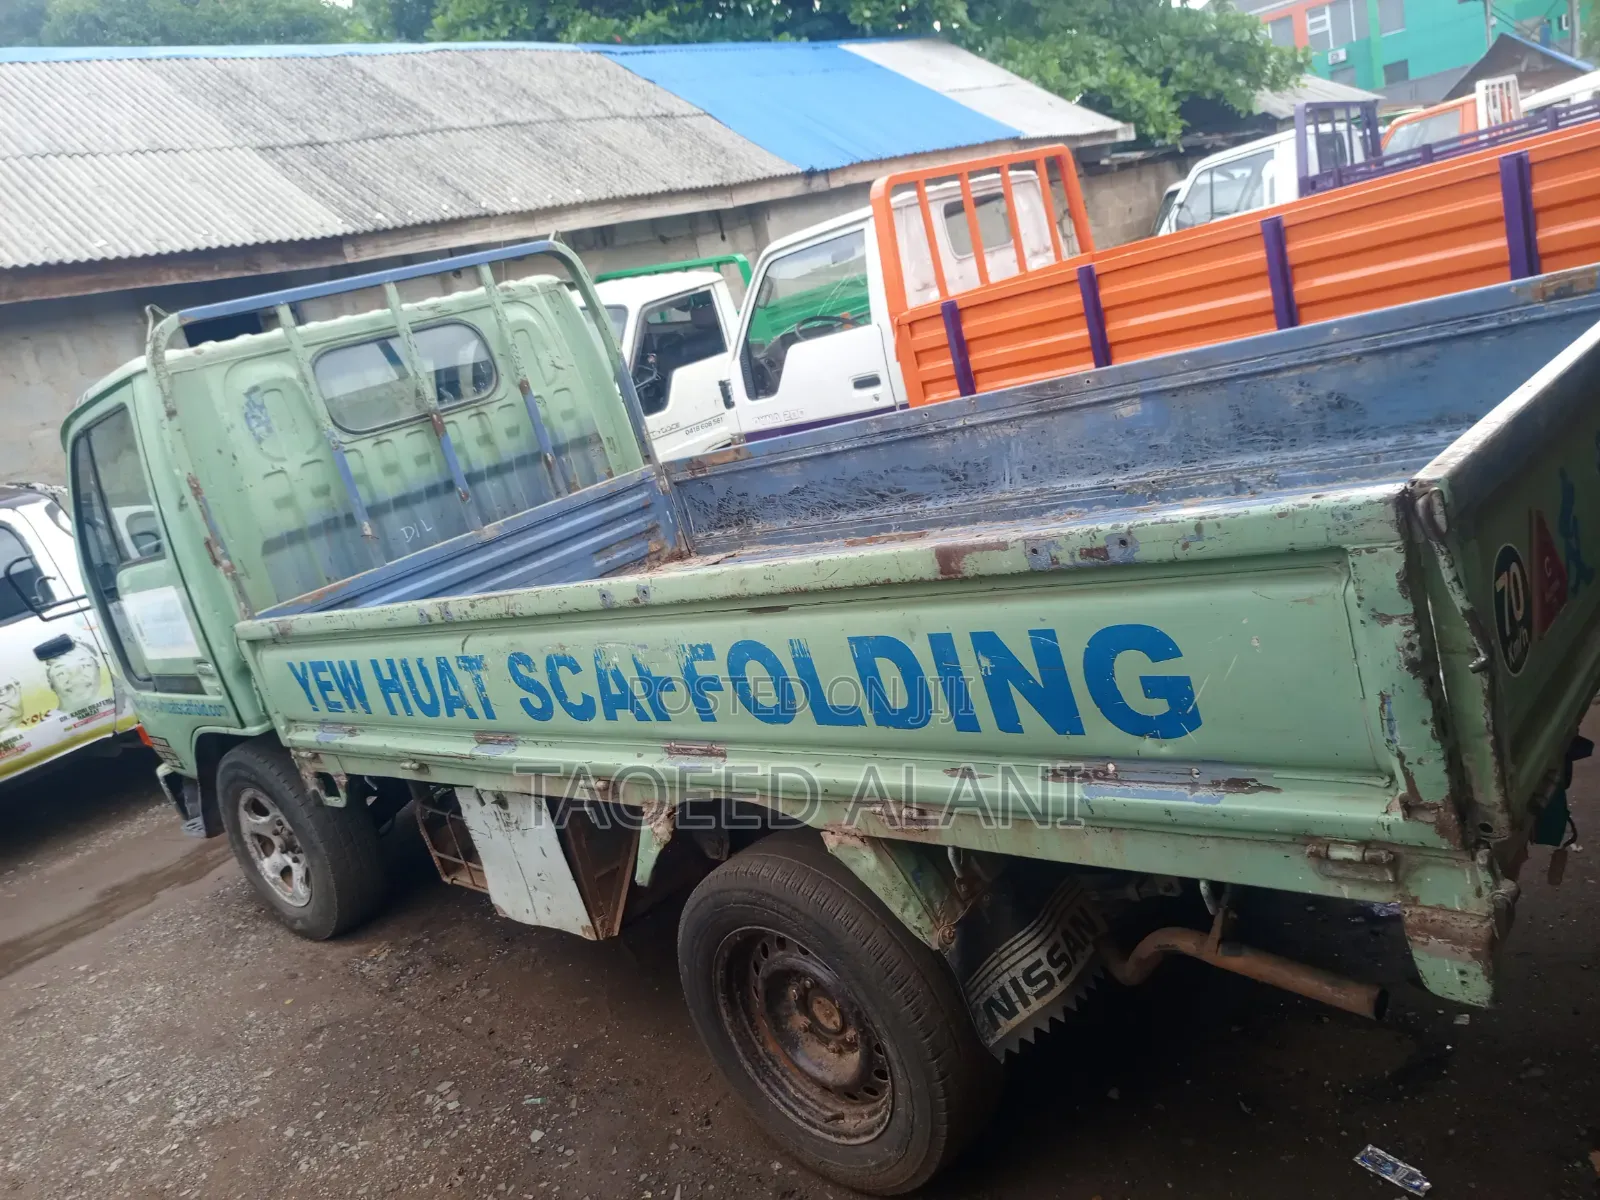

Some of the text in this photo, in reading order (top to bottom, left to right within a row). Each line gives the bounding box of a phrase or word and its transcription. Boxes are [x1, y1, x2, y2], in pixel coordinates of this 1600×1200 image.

[1495, 562, 1525, 638] 70
[287, 623, 1203, 740] YEW HUAT SCAFFOLDING
[982, 904, 1100, 1033] NISSAN
